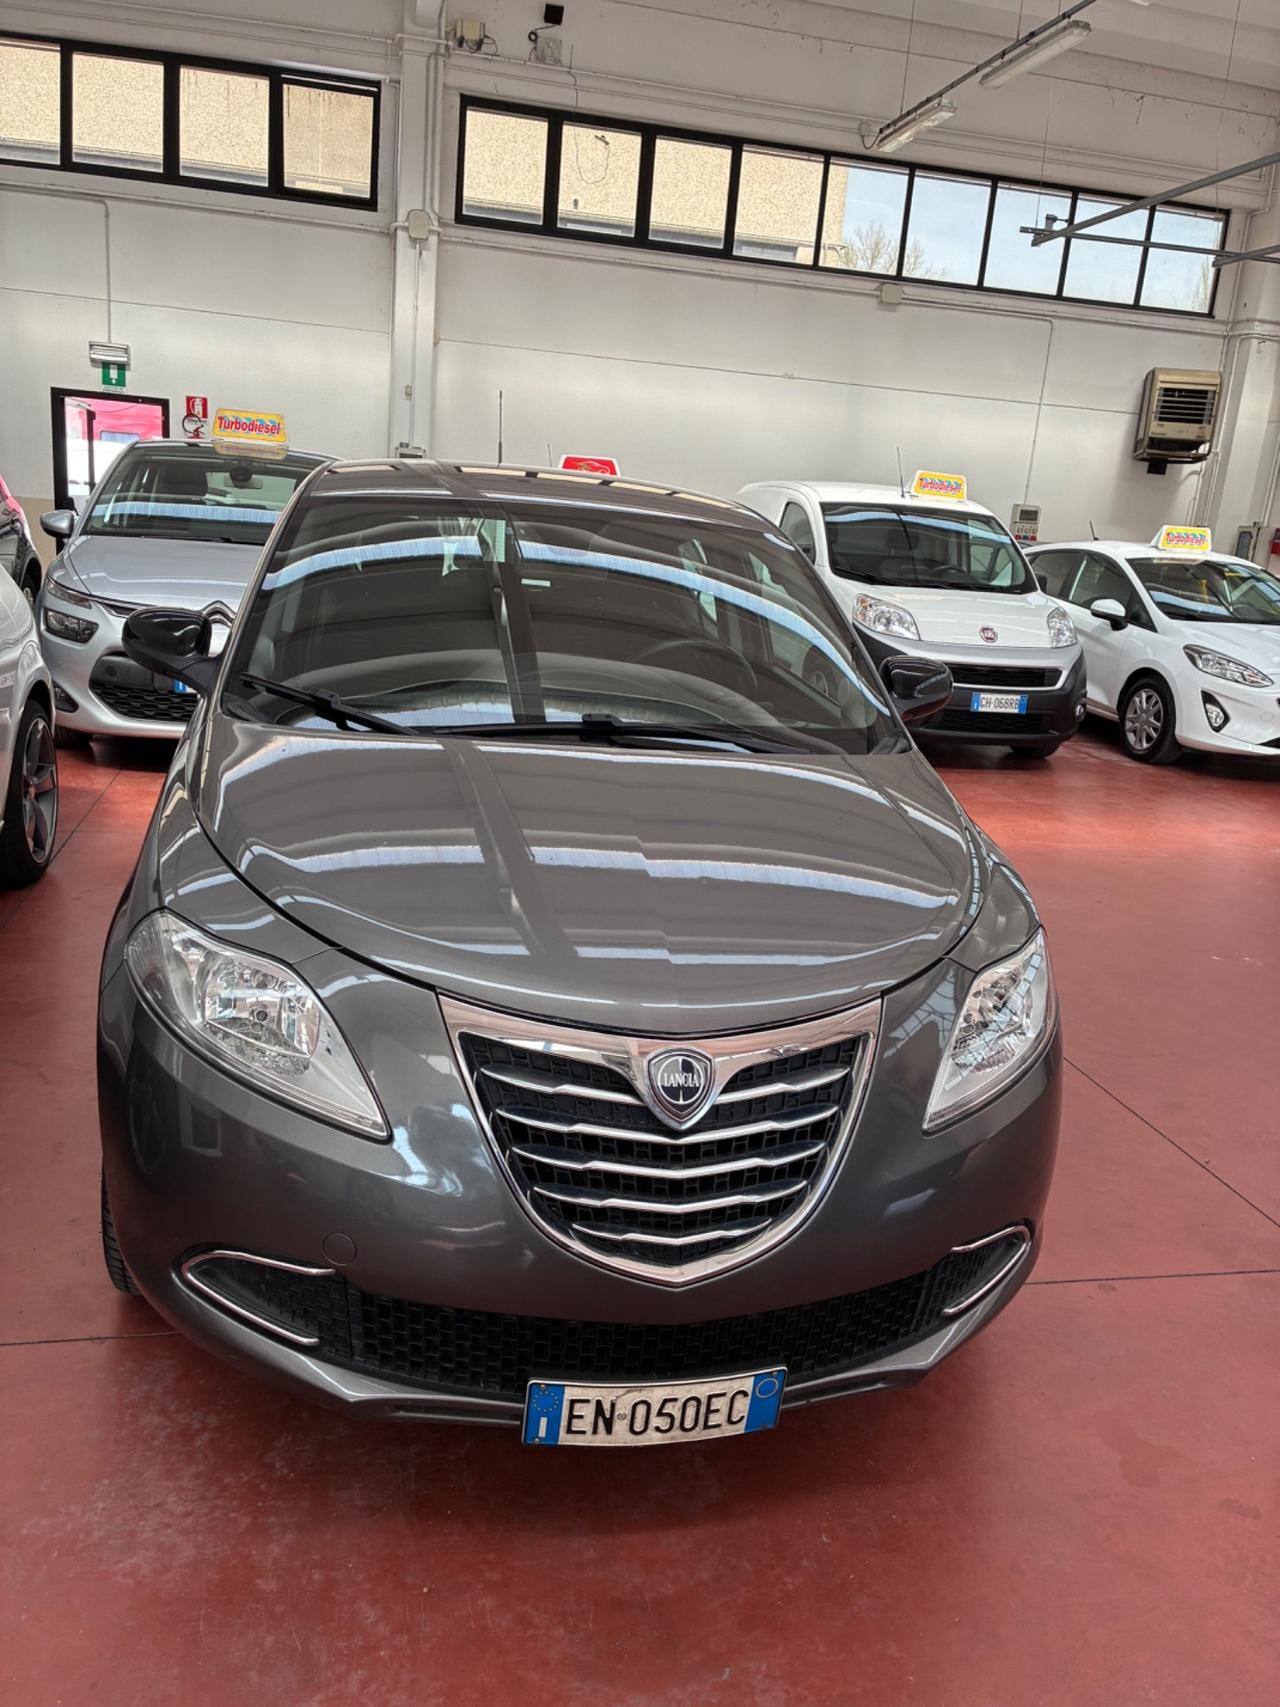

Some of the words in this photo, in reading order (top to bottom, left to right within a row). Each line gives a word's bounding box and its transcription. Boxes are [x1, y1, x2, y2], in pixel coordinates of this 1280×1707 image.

[218, 415, 281, 435] Turbodiesel
[919, 477, 962, 493] Turbodiesel
[1166, 532, 1206, 545] Turbodiesel
[664, 1073, 699, 1088] LANCIA
